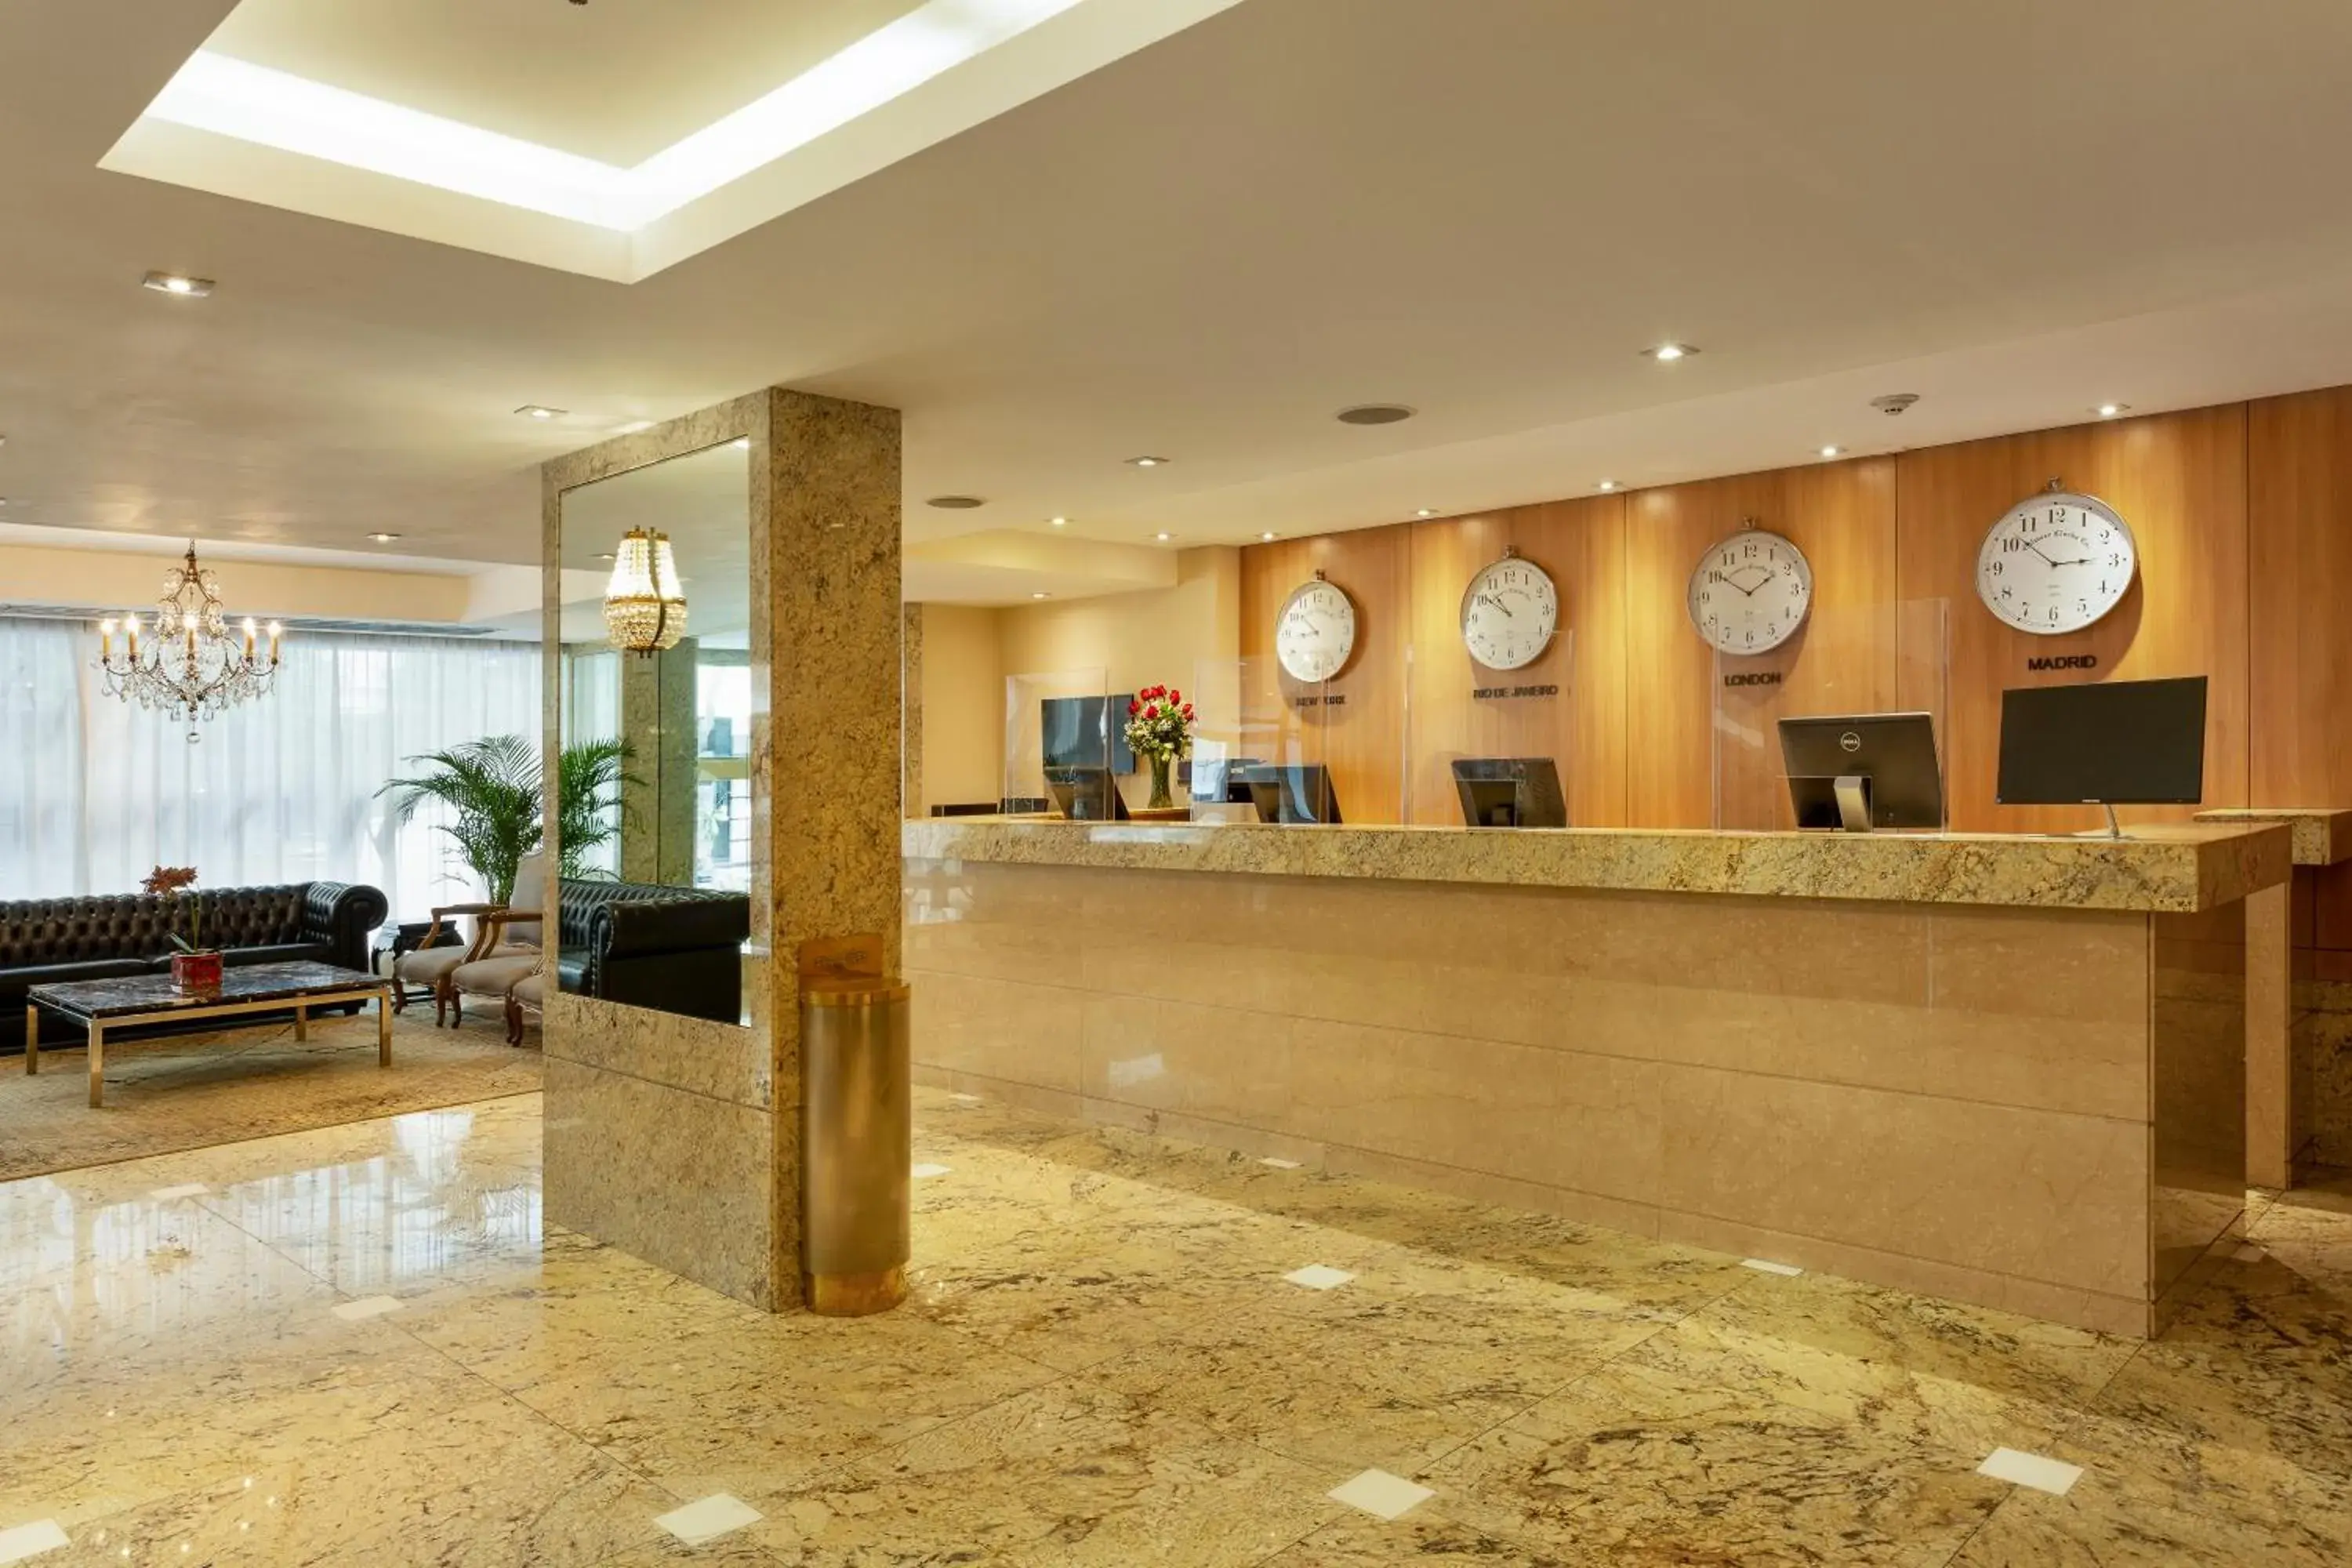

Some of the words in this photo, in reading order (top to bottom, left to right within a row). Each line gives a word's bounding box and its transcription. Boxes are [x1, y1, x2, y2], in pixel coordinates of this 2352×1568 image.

[2049, 508, 2066, 524] 12
[2082, 512, 2086, 527] 1
[2021, 517, 2036, 532] 11
[2100, 530, 2110, 544] 2
[1743, 545, 1757, 558] 12
[2002, 538, 2020, 553] 10
[1722, 552, 1735, 565] 11
[1769, 548, 1773, 561] 1
[2109, 554, 2119, 567] 3
[1784, 564, 1792, 575] 2
[1993, 561, 2003, 576] 9
[1488, 578, 1498, 590] 11
[1504, 570, 1515, 584] 12
[1708, 571, 1722, 583] 10
[1791, 583, 1799, 597] 3
[2002, 586, 2013, 600] 8
[2098, 579, 2107, 593] 4
[1701, 592, 1710, 604] 9
[2077, 598, 2086, 612] 5
[2022, 601, 2031, 618] 7
[2049, 606, 2059, 622] 6
[1745, 630, 1754, 643] 6
[2028, 655, 2097, 671] MADRID
[1725, 672, 1781, 687] LONDON
[1474, 688, 1492, 699] RIO
[1494, 688, 1508, 699] DE
[1512, 685, 1559, 698] JANEIRO
